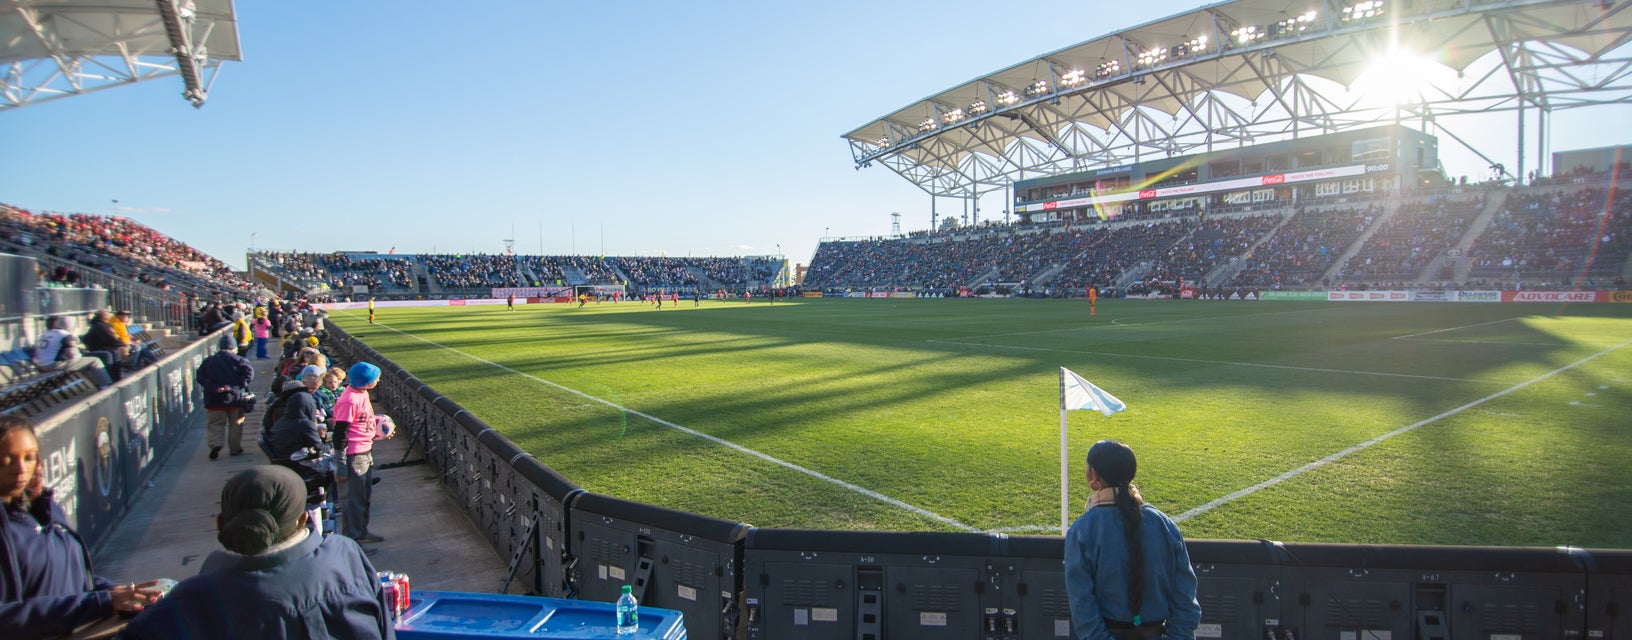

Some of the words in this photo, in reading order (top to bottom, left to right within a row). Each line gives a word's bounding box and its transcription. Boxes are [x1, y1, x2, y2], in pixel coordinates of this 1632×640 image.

[1367, 164, 1388, 172] 90:00
[1263, 175, 1284, 184] Coca-Cola
[1139, 190, 1156, 198] Coca-Cola
[1513, 291, 1596, 302] ADVOCARE
